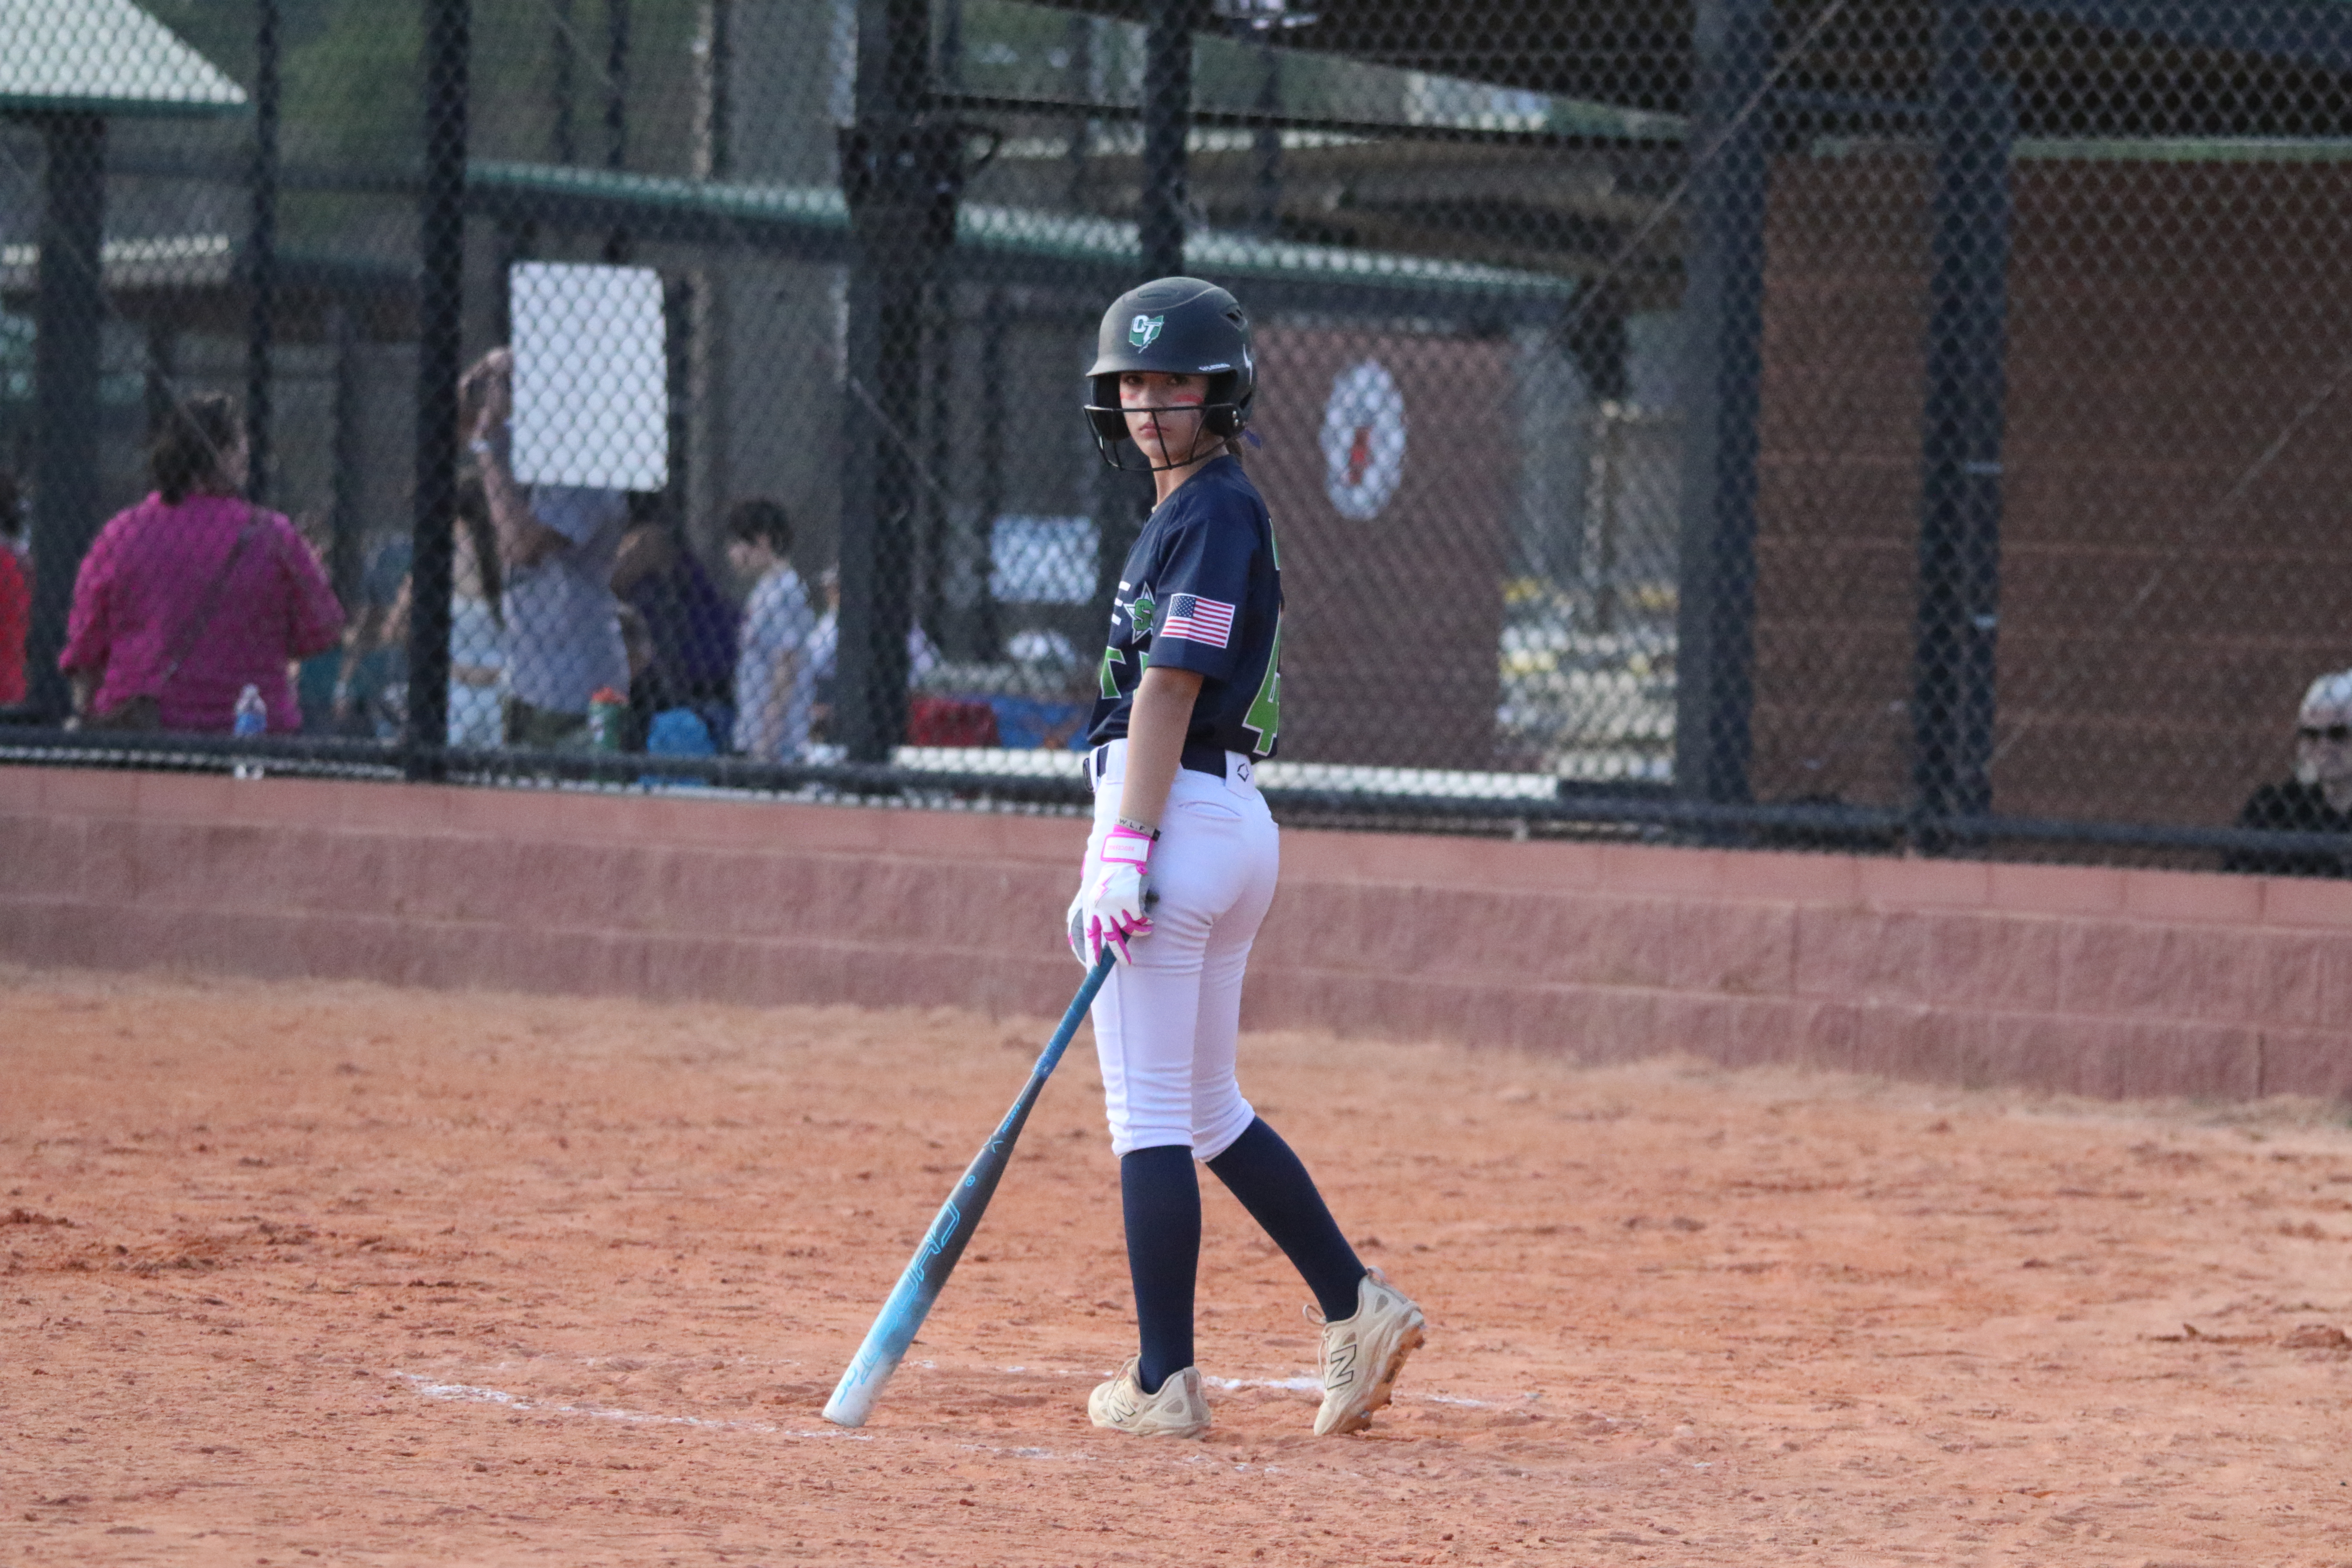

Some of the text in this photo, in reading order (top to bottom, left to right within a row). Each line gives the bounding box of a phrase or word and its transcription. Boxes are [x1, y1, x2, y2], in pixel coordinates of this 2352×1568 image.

[1001, 1103, 1020, 1133] EASTON
[1326, 1343, 1357, 1390] N
[1108, 1389, 1136, 1423] N
